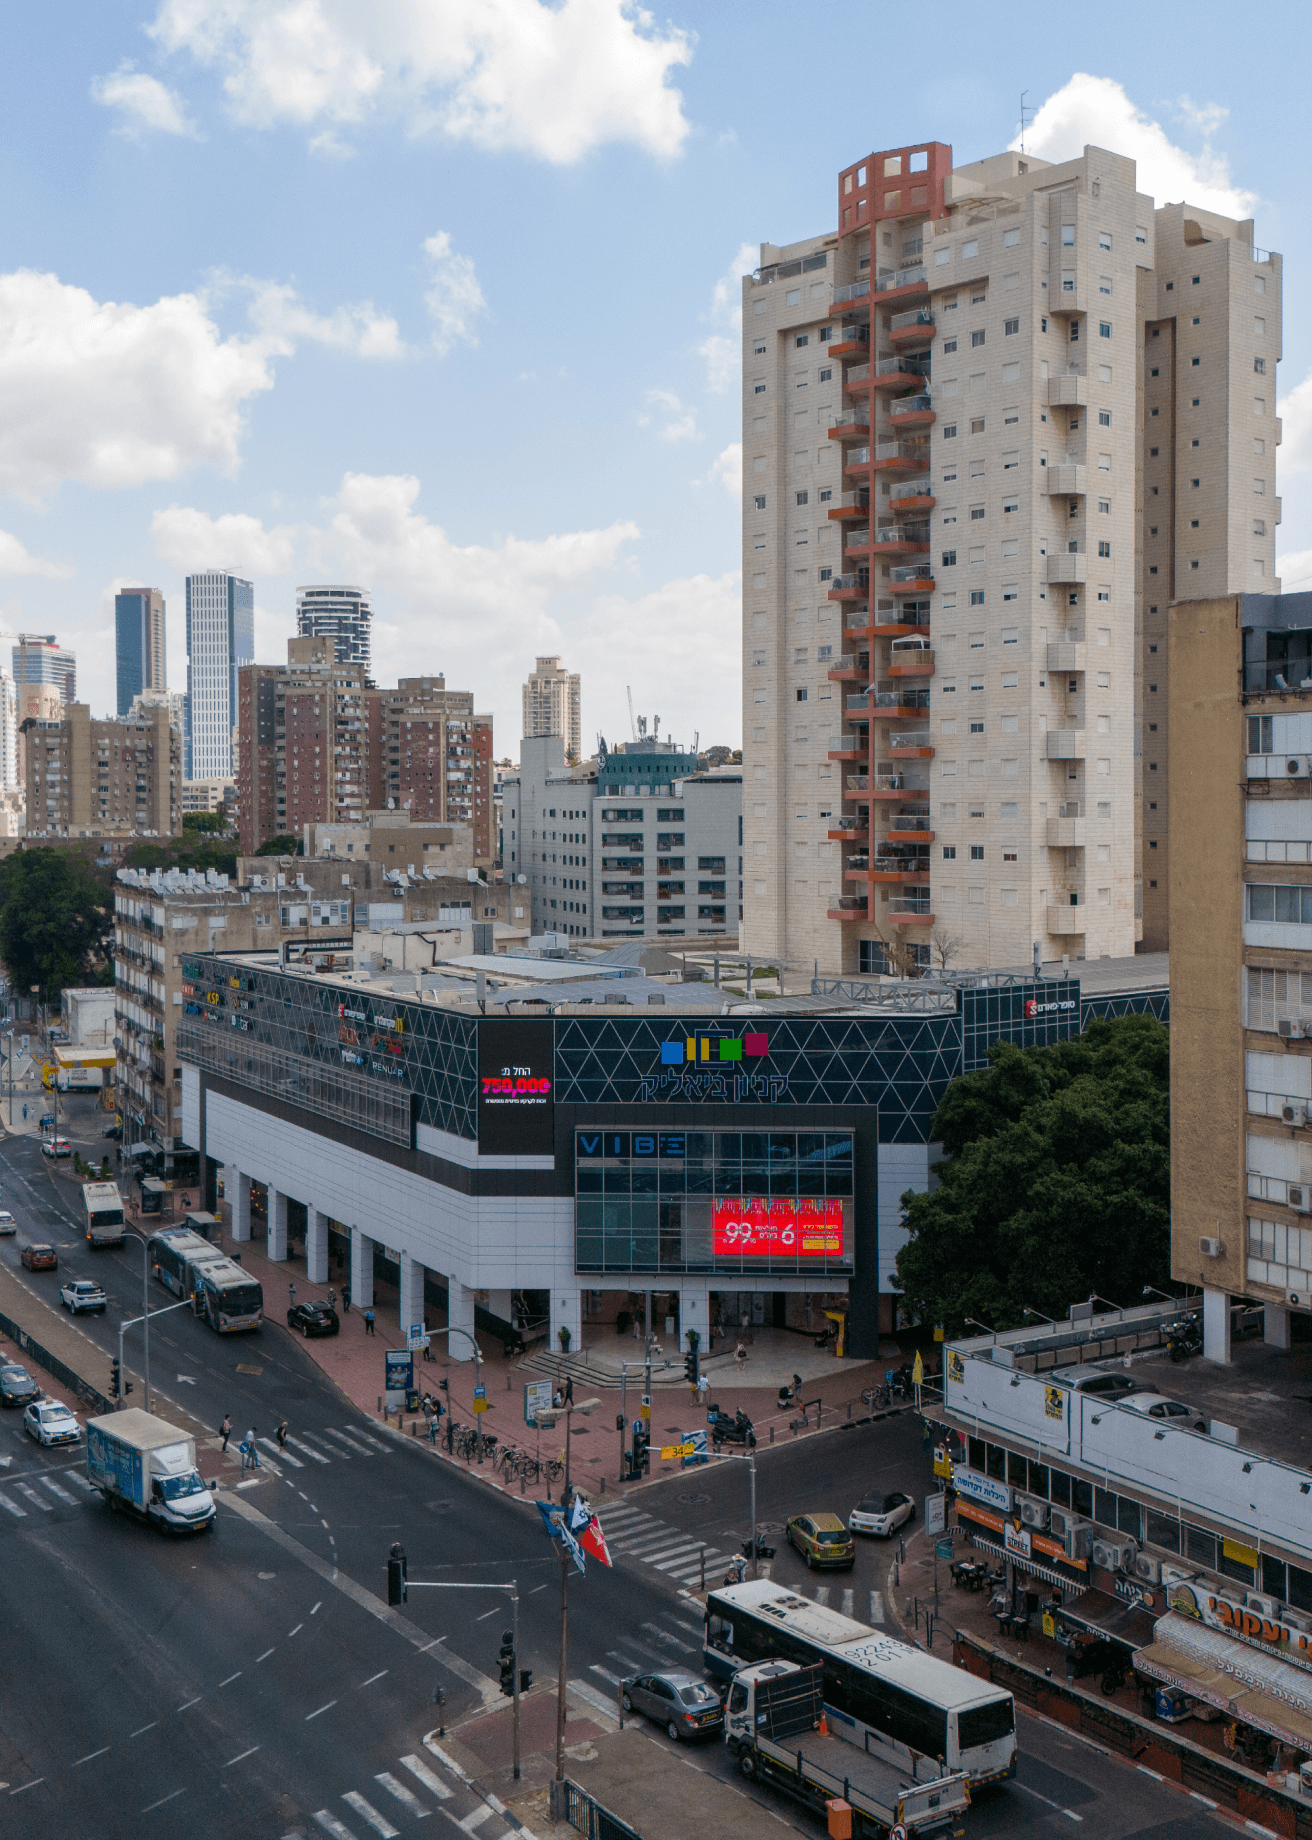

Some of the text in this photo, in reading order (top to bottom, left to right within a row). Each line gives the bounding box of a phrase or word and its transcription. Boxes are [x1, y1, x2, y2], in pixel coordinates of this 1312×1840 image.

[372, 1061, 404, 1077] RENUAR
[512, 1066, 531, 1076] החל
[641, 1067, 789, 1103] קניון ביאליק
[957, 1476, 983, 1493] דקדושה
[983, 1487, 1006, 1503] היכלות
[1007, 1536, 1029, 1552] STREET
[1208, 1596, 1290, 1641] יעקובי
[1217, 1658, 1306, 1709] חנות המפעל
